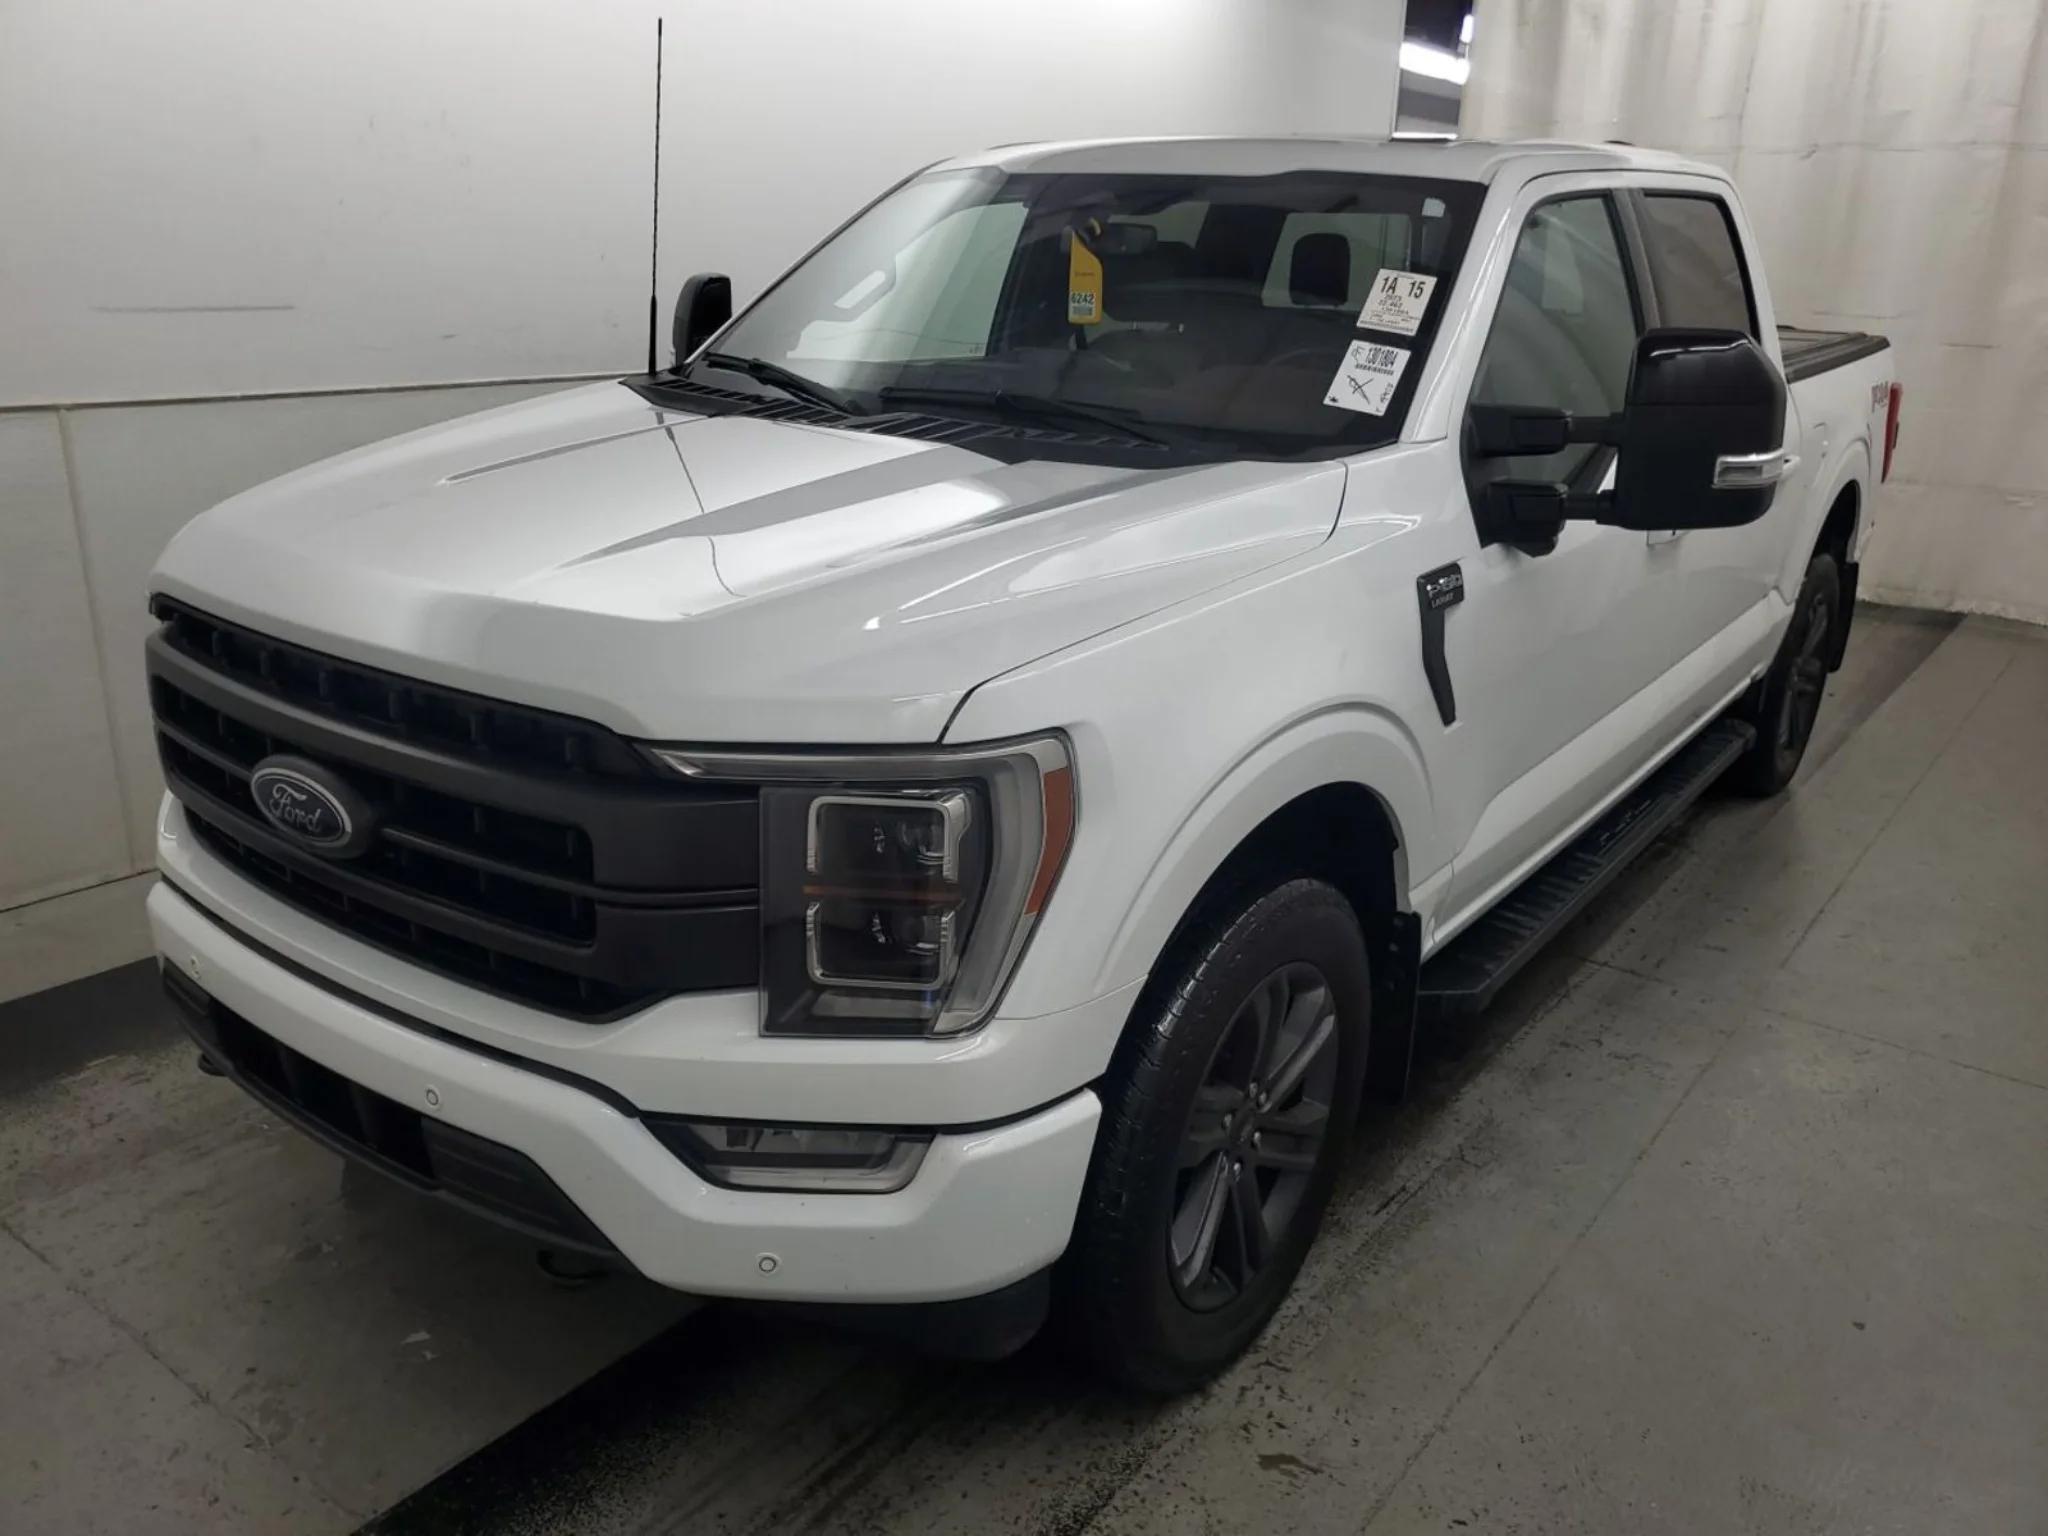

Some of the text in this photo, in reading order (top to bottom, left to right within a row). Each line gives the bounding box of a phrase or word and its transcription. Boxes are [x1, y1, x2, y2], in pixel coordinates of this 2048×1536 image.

[1380, 275, 1426, 298] 1A 15
[269, 783, 322, 833] Ford
